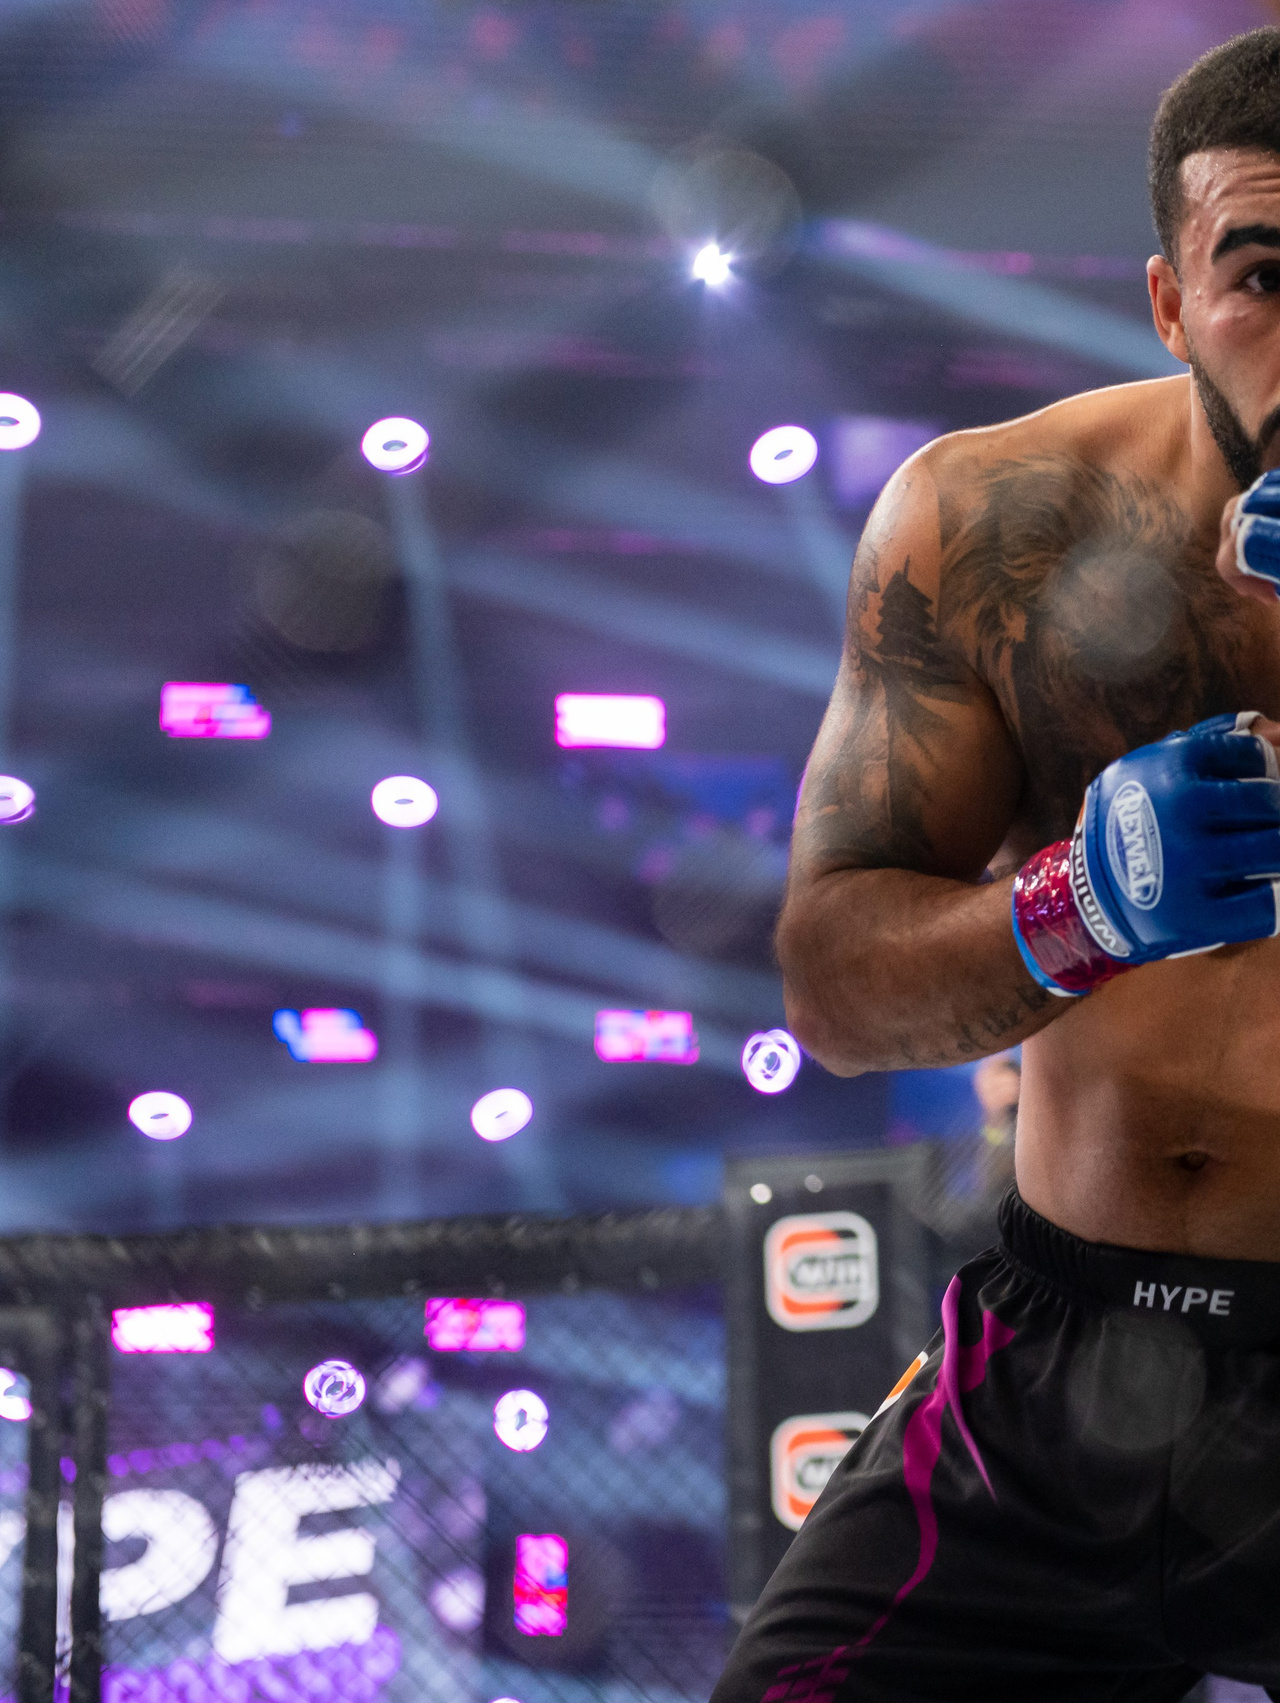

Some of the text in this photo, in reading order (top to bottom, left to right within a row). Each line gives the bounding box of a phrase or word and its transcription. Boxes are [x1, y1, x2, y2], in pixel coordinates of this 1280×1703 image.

[1113, 789, 1157, 900] REYVEL
[1132, 1280, 1235, 1316] HYPE
[55, 1458, 399, 1674] PE
